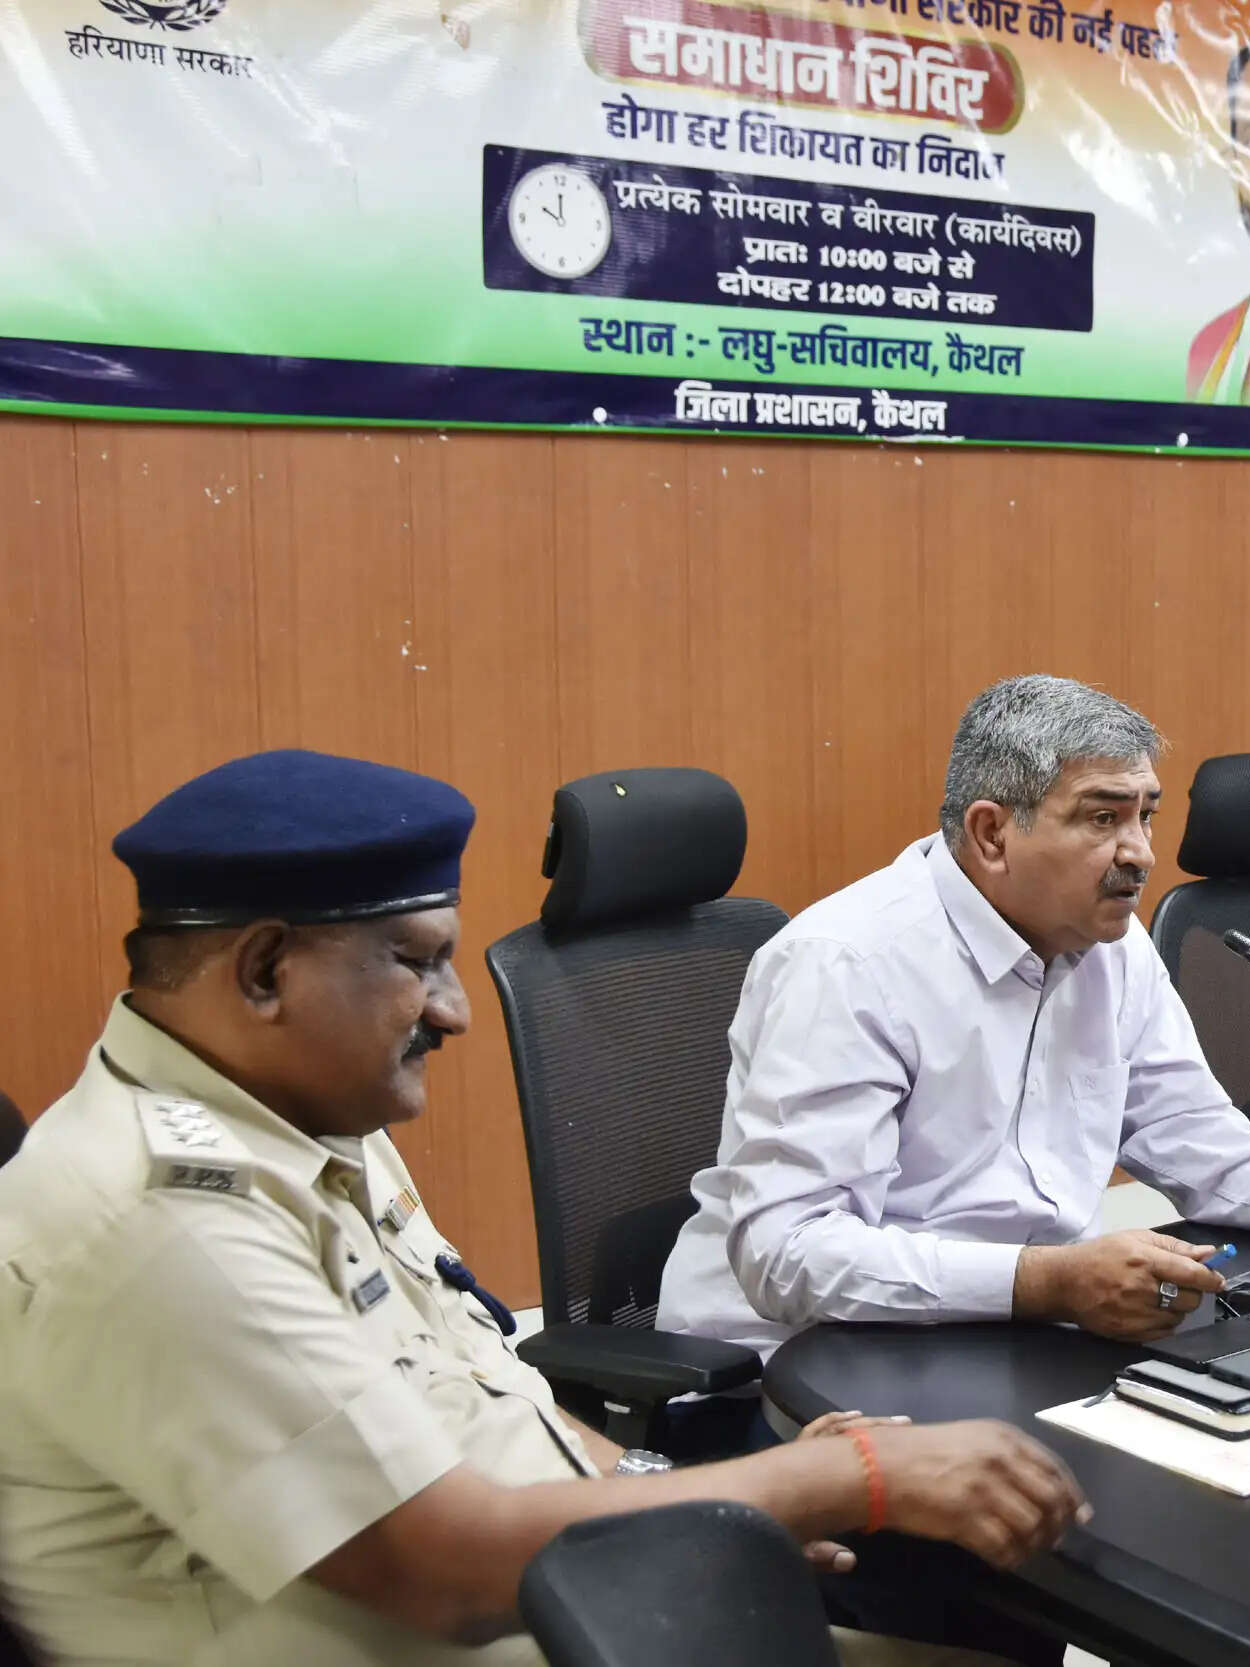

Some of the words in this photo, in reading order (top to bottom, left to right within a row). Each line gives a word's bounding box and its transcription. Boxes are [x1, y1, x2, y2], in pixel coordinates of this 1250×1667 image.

[65, 24, 165, 66] हरियाणा
[173, 46, 253, 78] सरकार
[1027, 0, 1066, 43] की
[1071, 9, 1113, 53] नई
[623, 16, 843, 99] समाधान
[850, 37, 989, 121] शिविर
[600, 93, 678, 144] होगा
[685, 112, 730, 150] हर
[737, 110, 864, 167] शिकायत
[870, 137, 911, 172] का
[612, 174, 702, 215] प्रत्येक
[708, 182, 812, 228] सोमवार
[818, 202, 844, 229] व
[850, 198, 940, 239] वीरवार
[945, 212, 1082, 258] (कार्यदिवस)
[820, 244, 888, 272] 10:00
[893, 247, 942, 277] बजे
[947, 250, 976, 280] से
[716, 264, 813, 302] दोपहर
[817, 280, 887, 306] 12:00
[891, 281, 941, 311] बजे
[946, 290, 998, 315] तक
[579, 317, 677, 357] स्थान
[717, 324, 939, 376] लघु-सचिवालय,
[945, 331, 1025, 377] कैथल
[673, 379, 751, 424] जिला
[752, 392, 868, 433] प्रशासन,
[871, 388, 948, 431] कैथल
